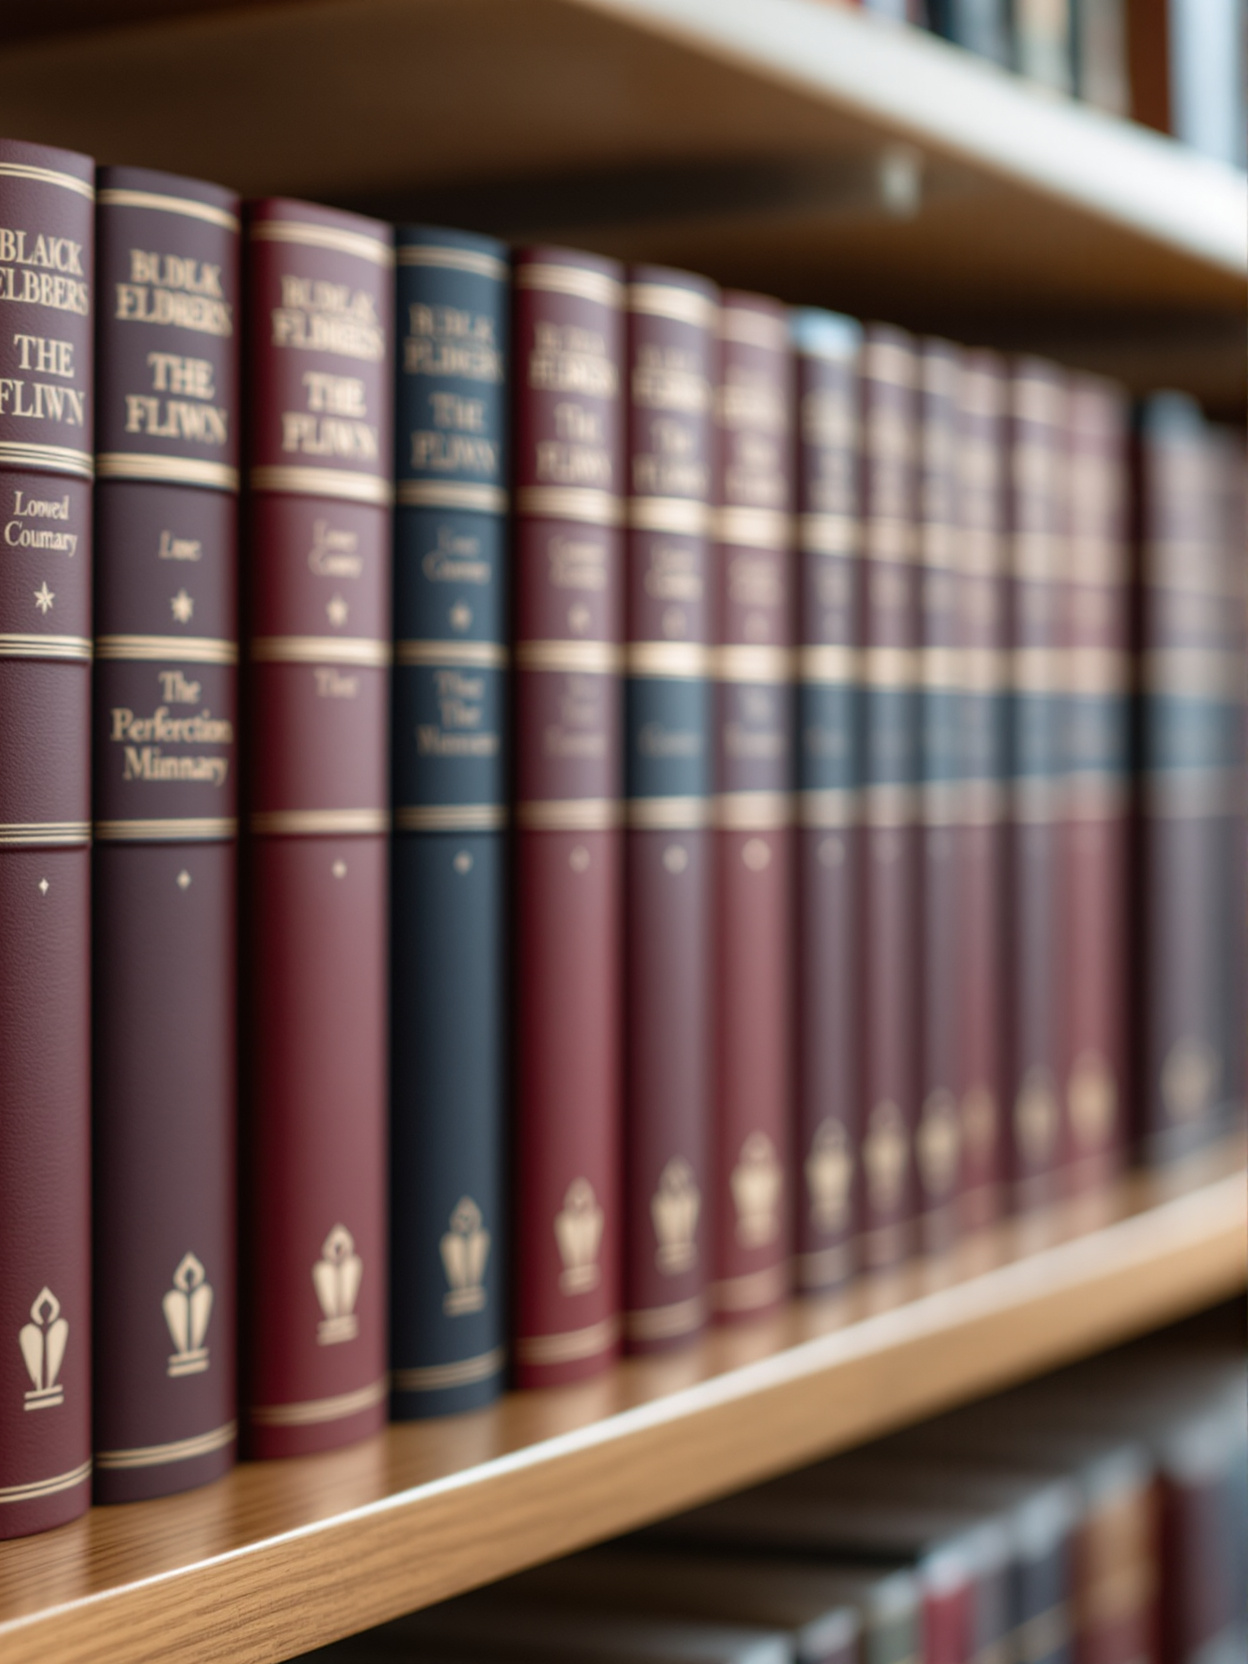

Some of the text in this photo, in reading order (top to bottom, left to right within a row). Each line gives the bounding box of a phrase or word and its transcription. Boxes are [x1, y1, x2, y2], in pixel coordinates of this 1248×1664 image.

[13, 334, 75, 378] THE
[147, 352, 216, 400] THE
[125, 394, 228, 446] FLIWN
[158, 670, 201, 704] The
